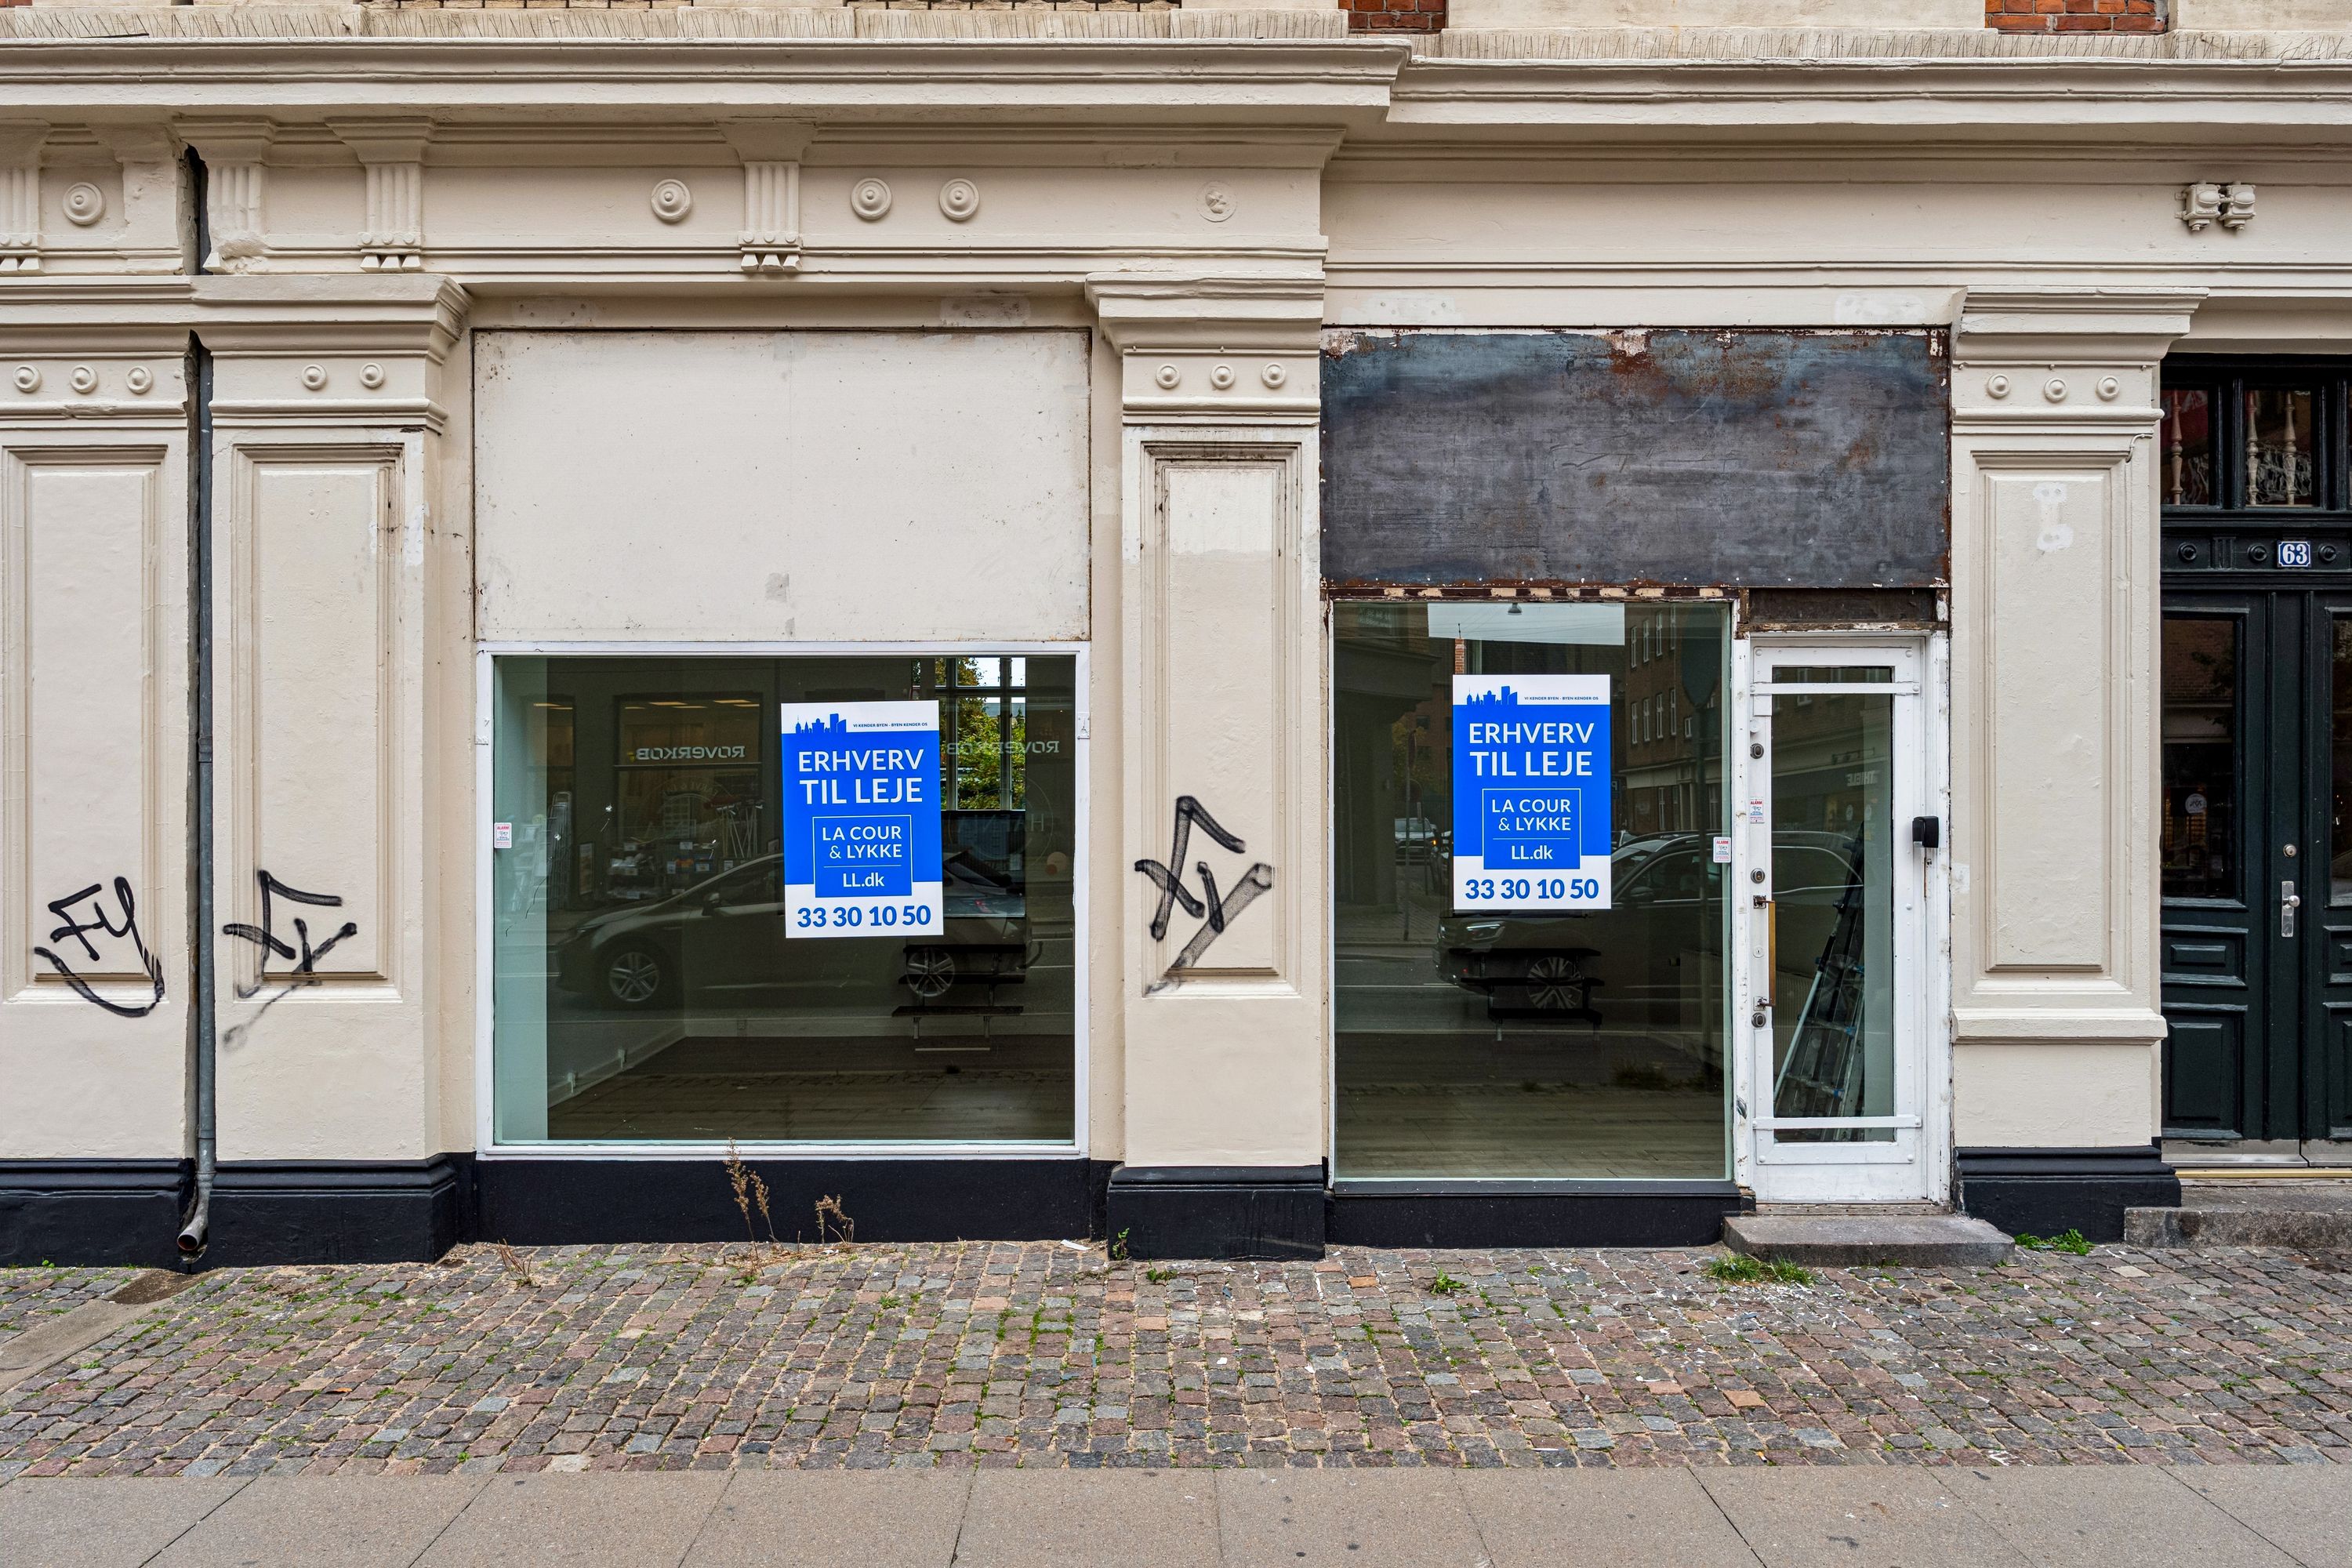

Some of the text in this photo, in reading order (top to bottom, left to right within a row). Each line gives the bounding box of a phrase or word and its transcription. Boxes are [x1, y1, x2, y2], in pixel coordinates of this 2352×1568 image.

[2282, 544, 2308, 564] 63
[1470, 723, 1594, 743] ERHVERV
[799, 750, 924, 771] ERHVERV
[1470, 752, 1592, 775] TIL LEJE
[800, 778, 922, 804] TIL LEJE
[1493, 800, 1570, 812] LA COUR
[823, 826, 901, 840] LA COUR
[1499, 818, 1570, 830] & LYKKE
[830, 844, 902, 858] & LYKKE
[1512, 845, 1552, 859] LL.dk
[844, 873, 884, 887] LL.dk
[1465, 879, 1599, 899] 33 30 10 50
[797, 906, 931, 927] 33 30 10 50
